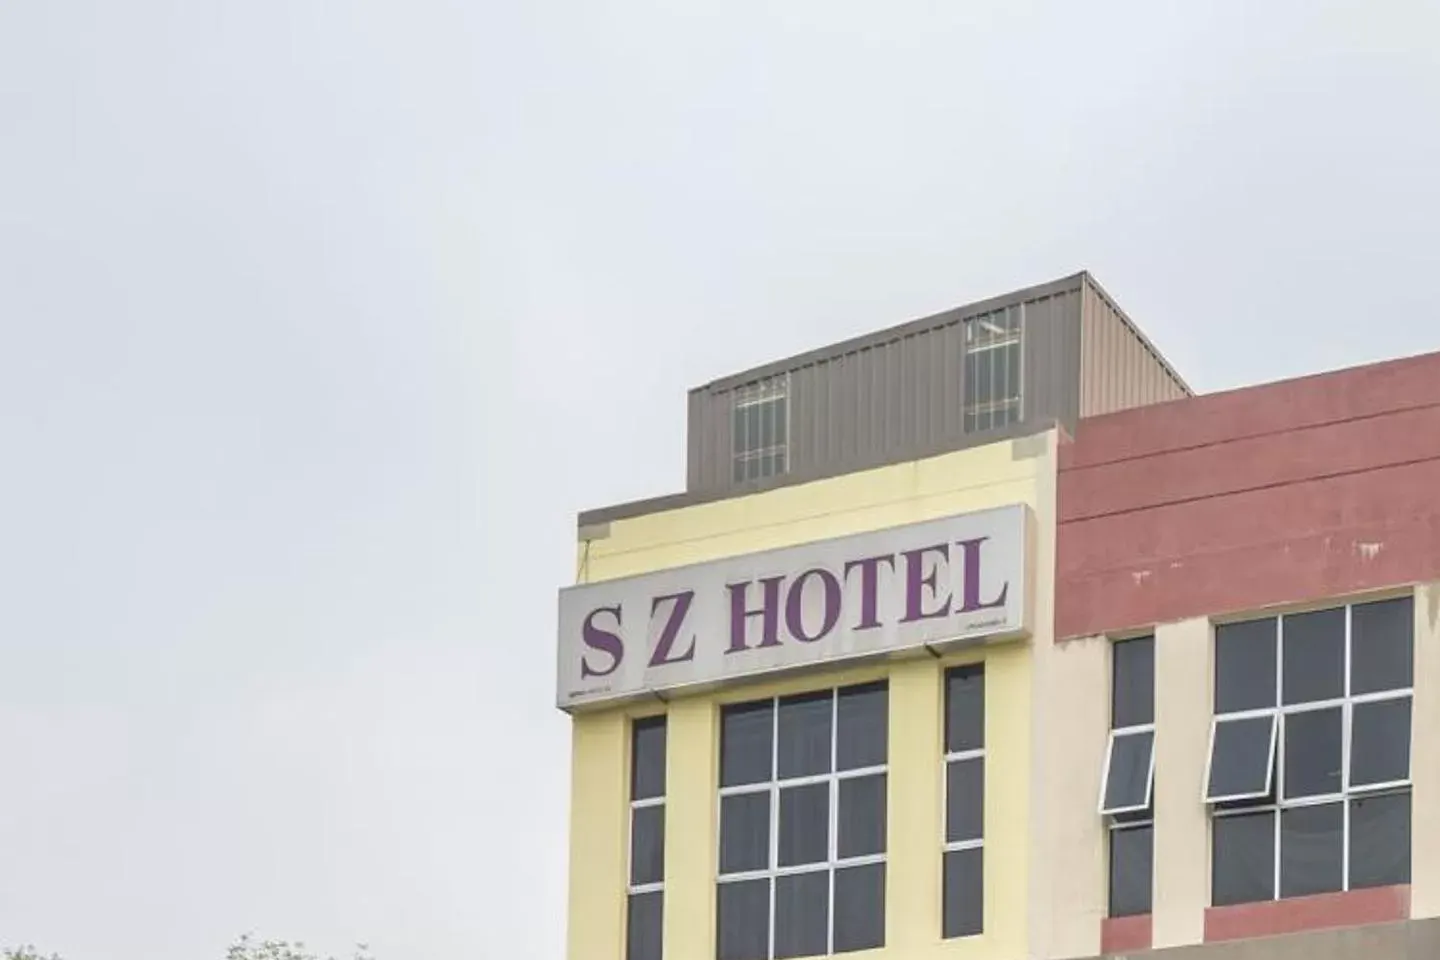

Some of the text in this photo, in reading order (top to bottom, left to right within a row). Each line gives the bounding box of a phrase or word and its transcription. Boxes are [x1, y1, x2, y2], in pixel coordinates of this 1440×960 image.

[580, 536, 1010, 680] S Z HOTEL
